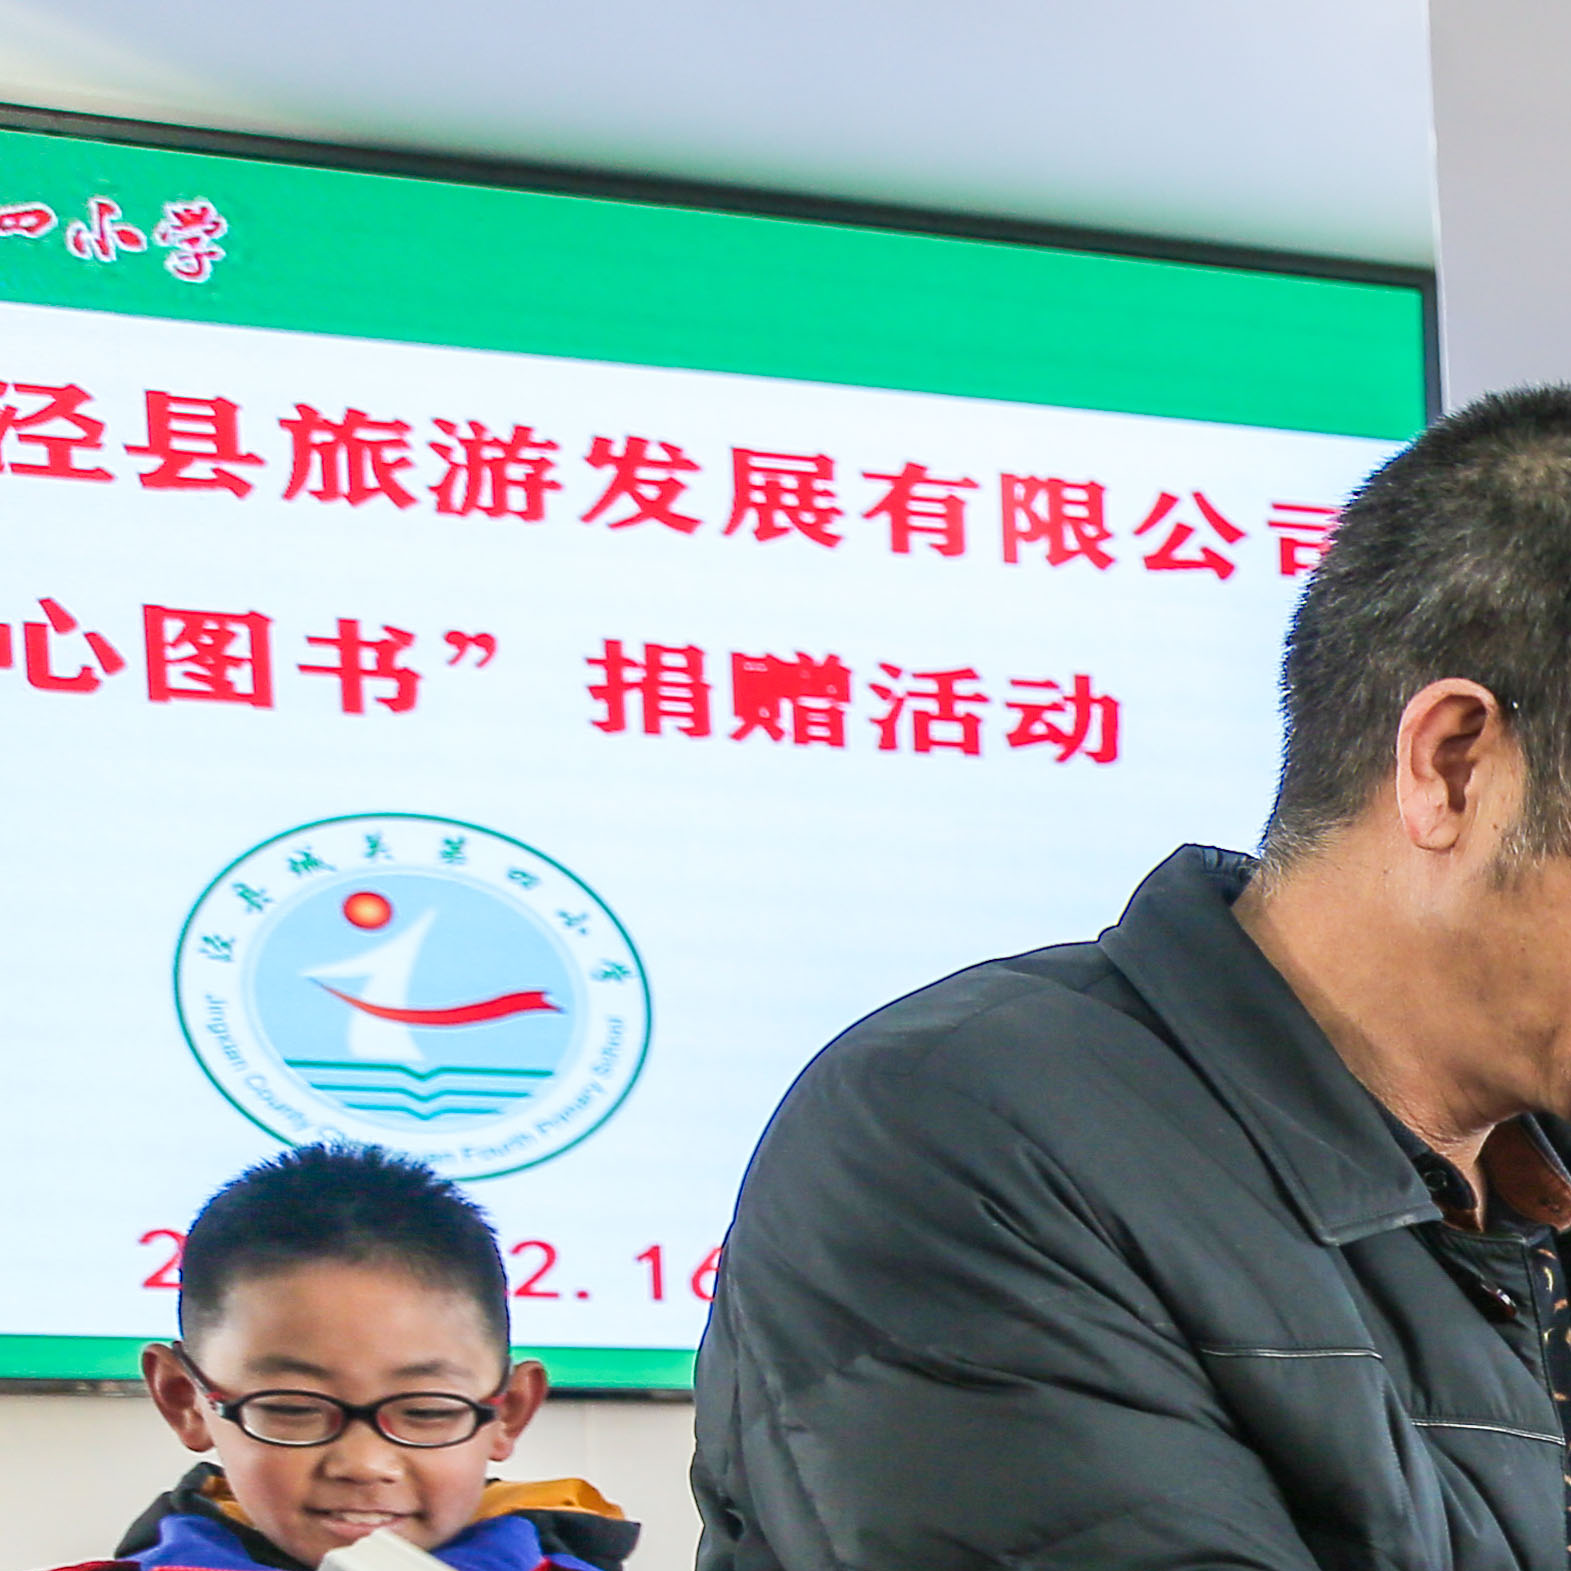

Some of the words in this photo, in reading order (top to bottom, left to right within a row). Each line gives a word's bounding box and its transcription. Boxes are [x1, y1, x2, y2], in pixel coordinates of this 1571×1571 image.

[0, 379, 1345, 580] 泾县旅游发展有限公司
[585, 638, 1123, 764] 捐赠活动
